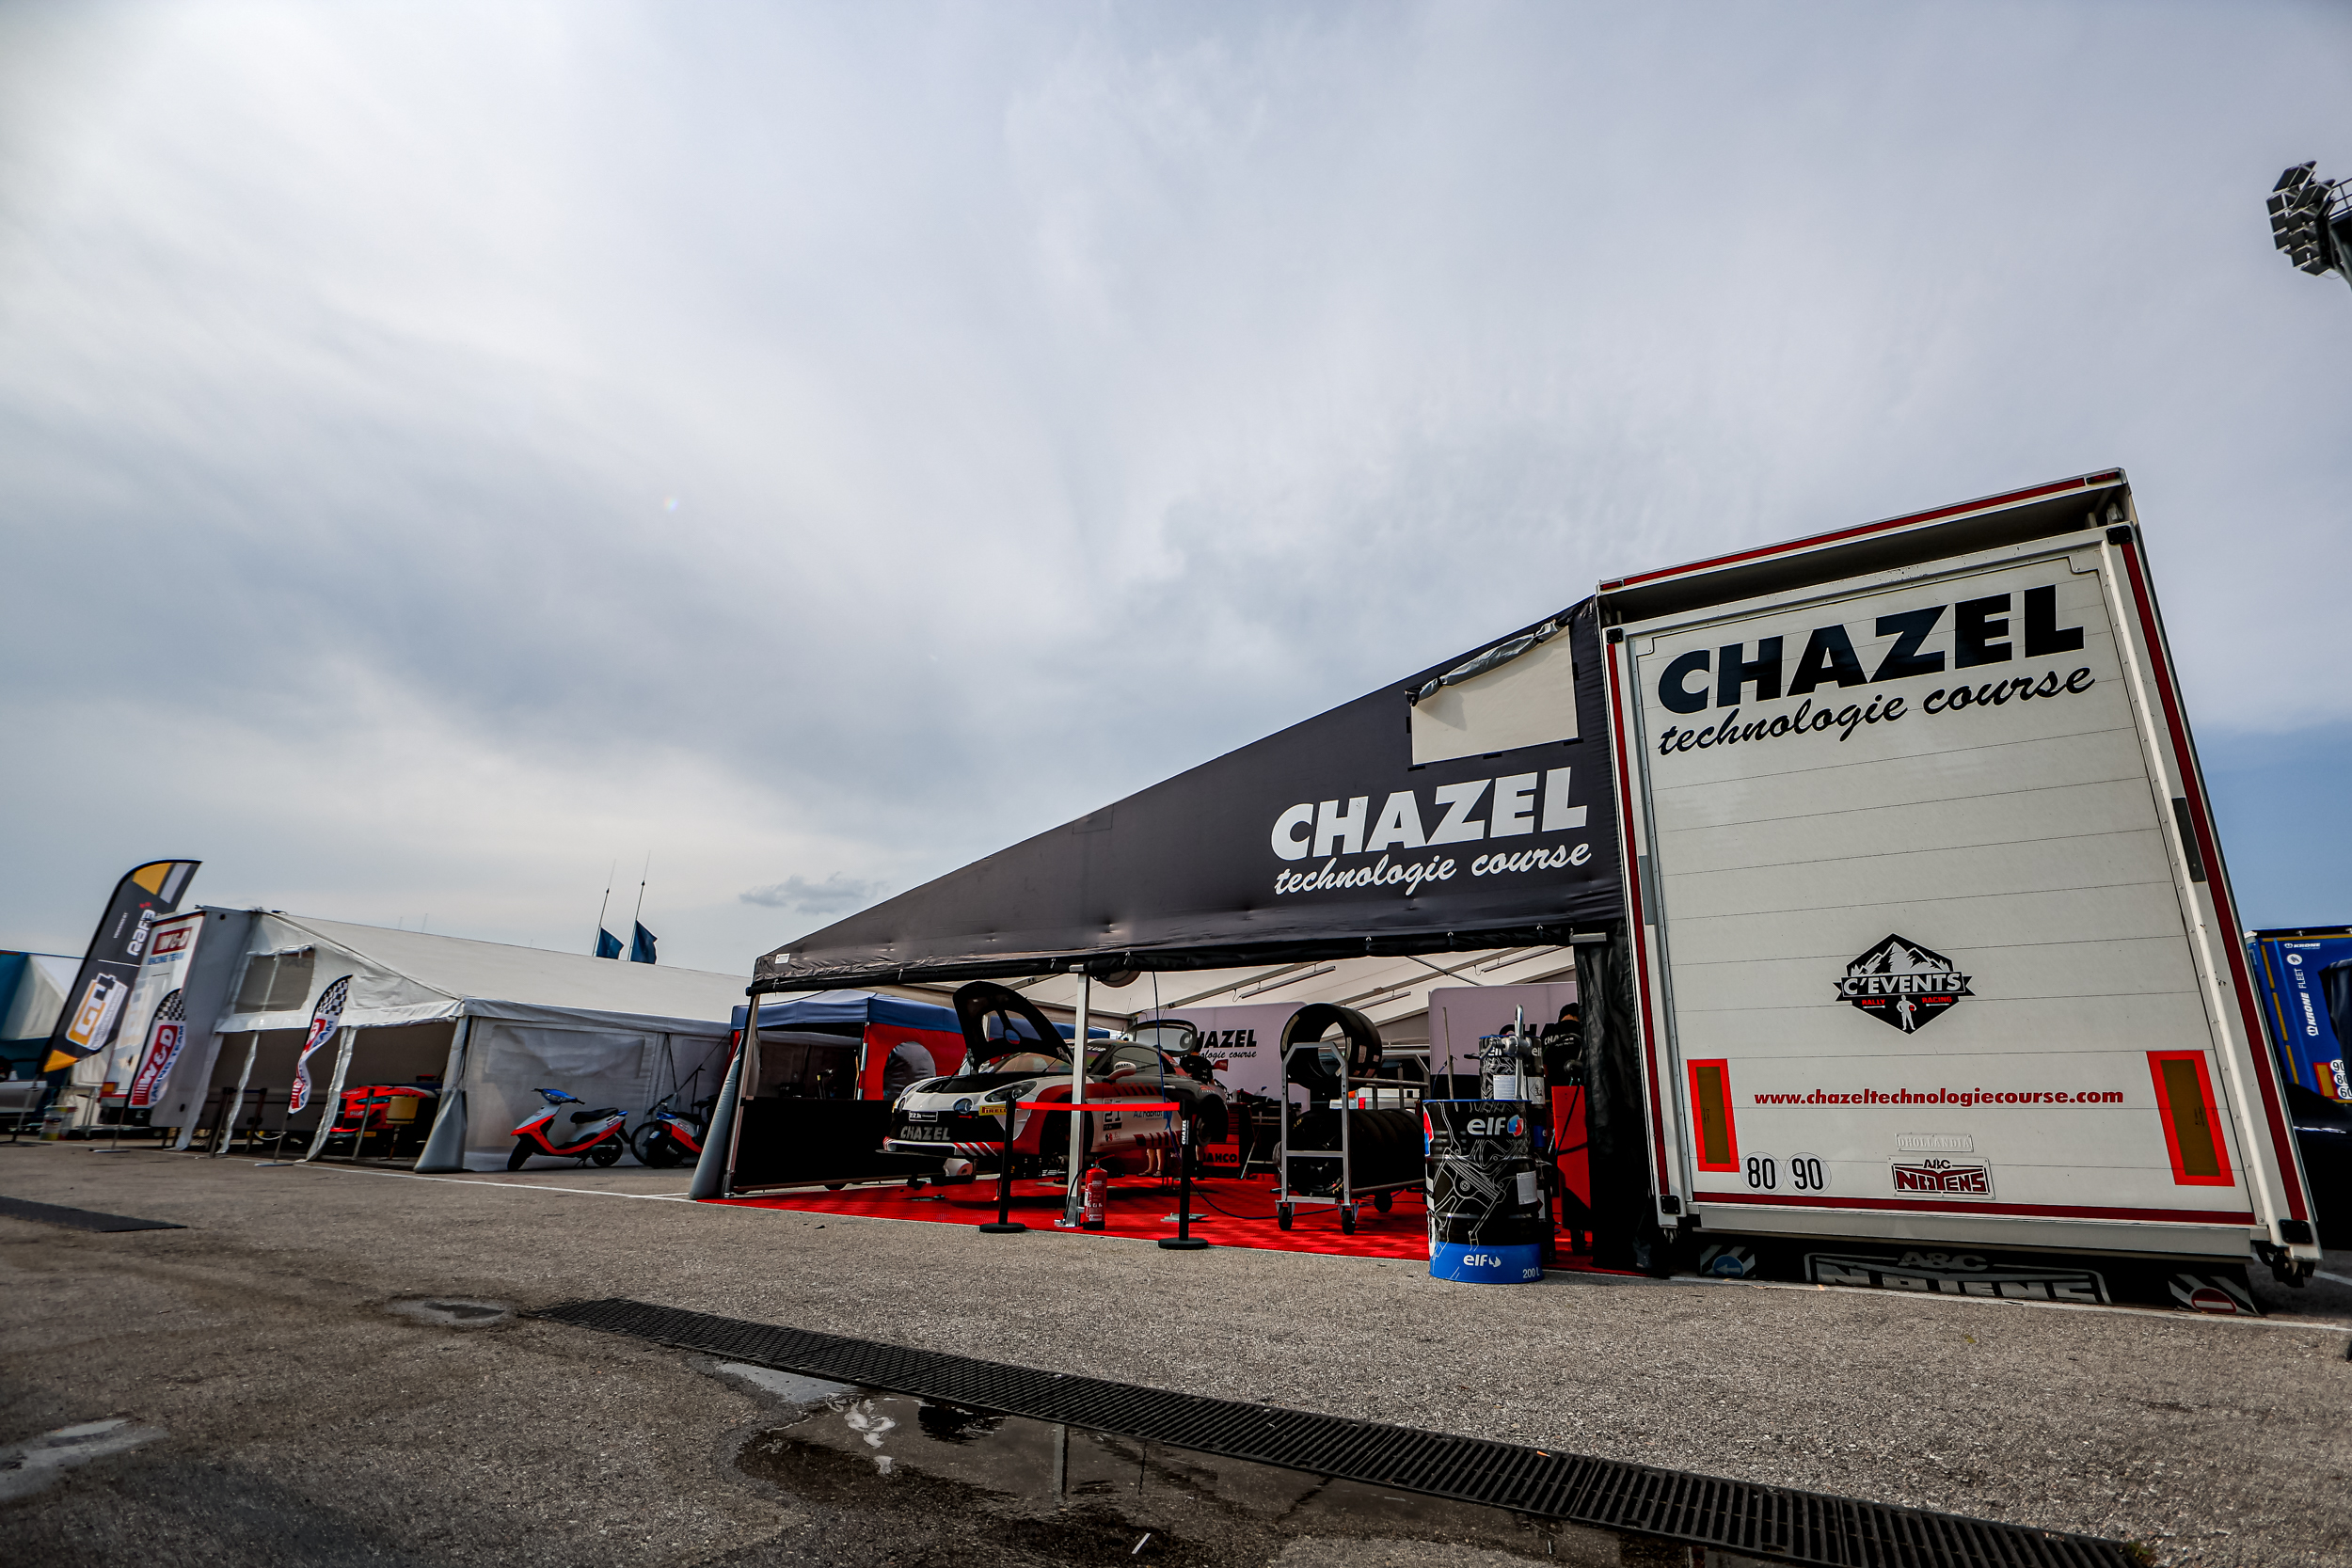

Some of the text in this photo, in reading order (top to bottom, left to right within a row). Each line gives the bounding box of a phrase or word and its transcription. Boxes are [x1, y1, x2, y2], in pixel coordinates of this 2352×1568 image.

[1658, 585, 2084, 714] CHAZEL
[1660, 666, 2095, 755] technologie course
[1271, 767, 1588, 861] CHAZEL
[1273, 843, 1592, 895] technologie course
[157, 931, 189, 950] W&D
[1843, 973, 1962, 995] C'EVENTS
[1922, 995, 1952, 1004] RACING
[2294, 968, 2318, 1026] KRONE FLEET
[138, 1027, 175, 1085] W&D
[1229, 1051, 1257, 1059] course
[1754, 1087, 2123, 1107] www.chazeltechnologiecourse.com
[900, 1126, 950, 1140] CHAZEL
[1467, 1117, 1506, 1135] elf
[1899, 1136, 1971, 1148] DHOLLANDIA
[1747, 1157, 1776, 1190] 80
[1923, 1159, 1951, 1169] A&C
[1792, 1158, 1823, 1191] 90
[1464, 1255, 1488, 1266] elf
[1898, 1251, 1988, 1270] A&C
[1523, 1271, 1535, 1279] 200
